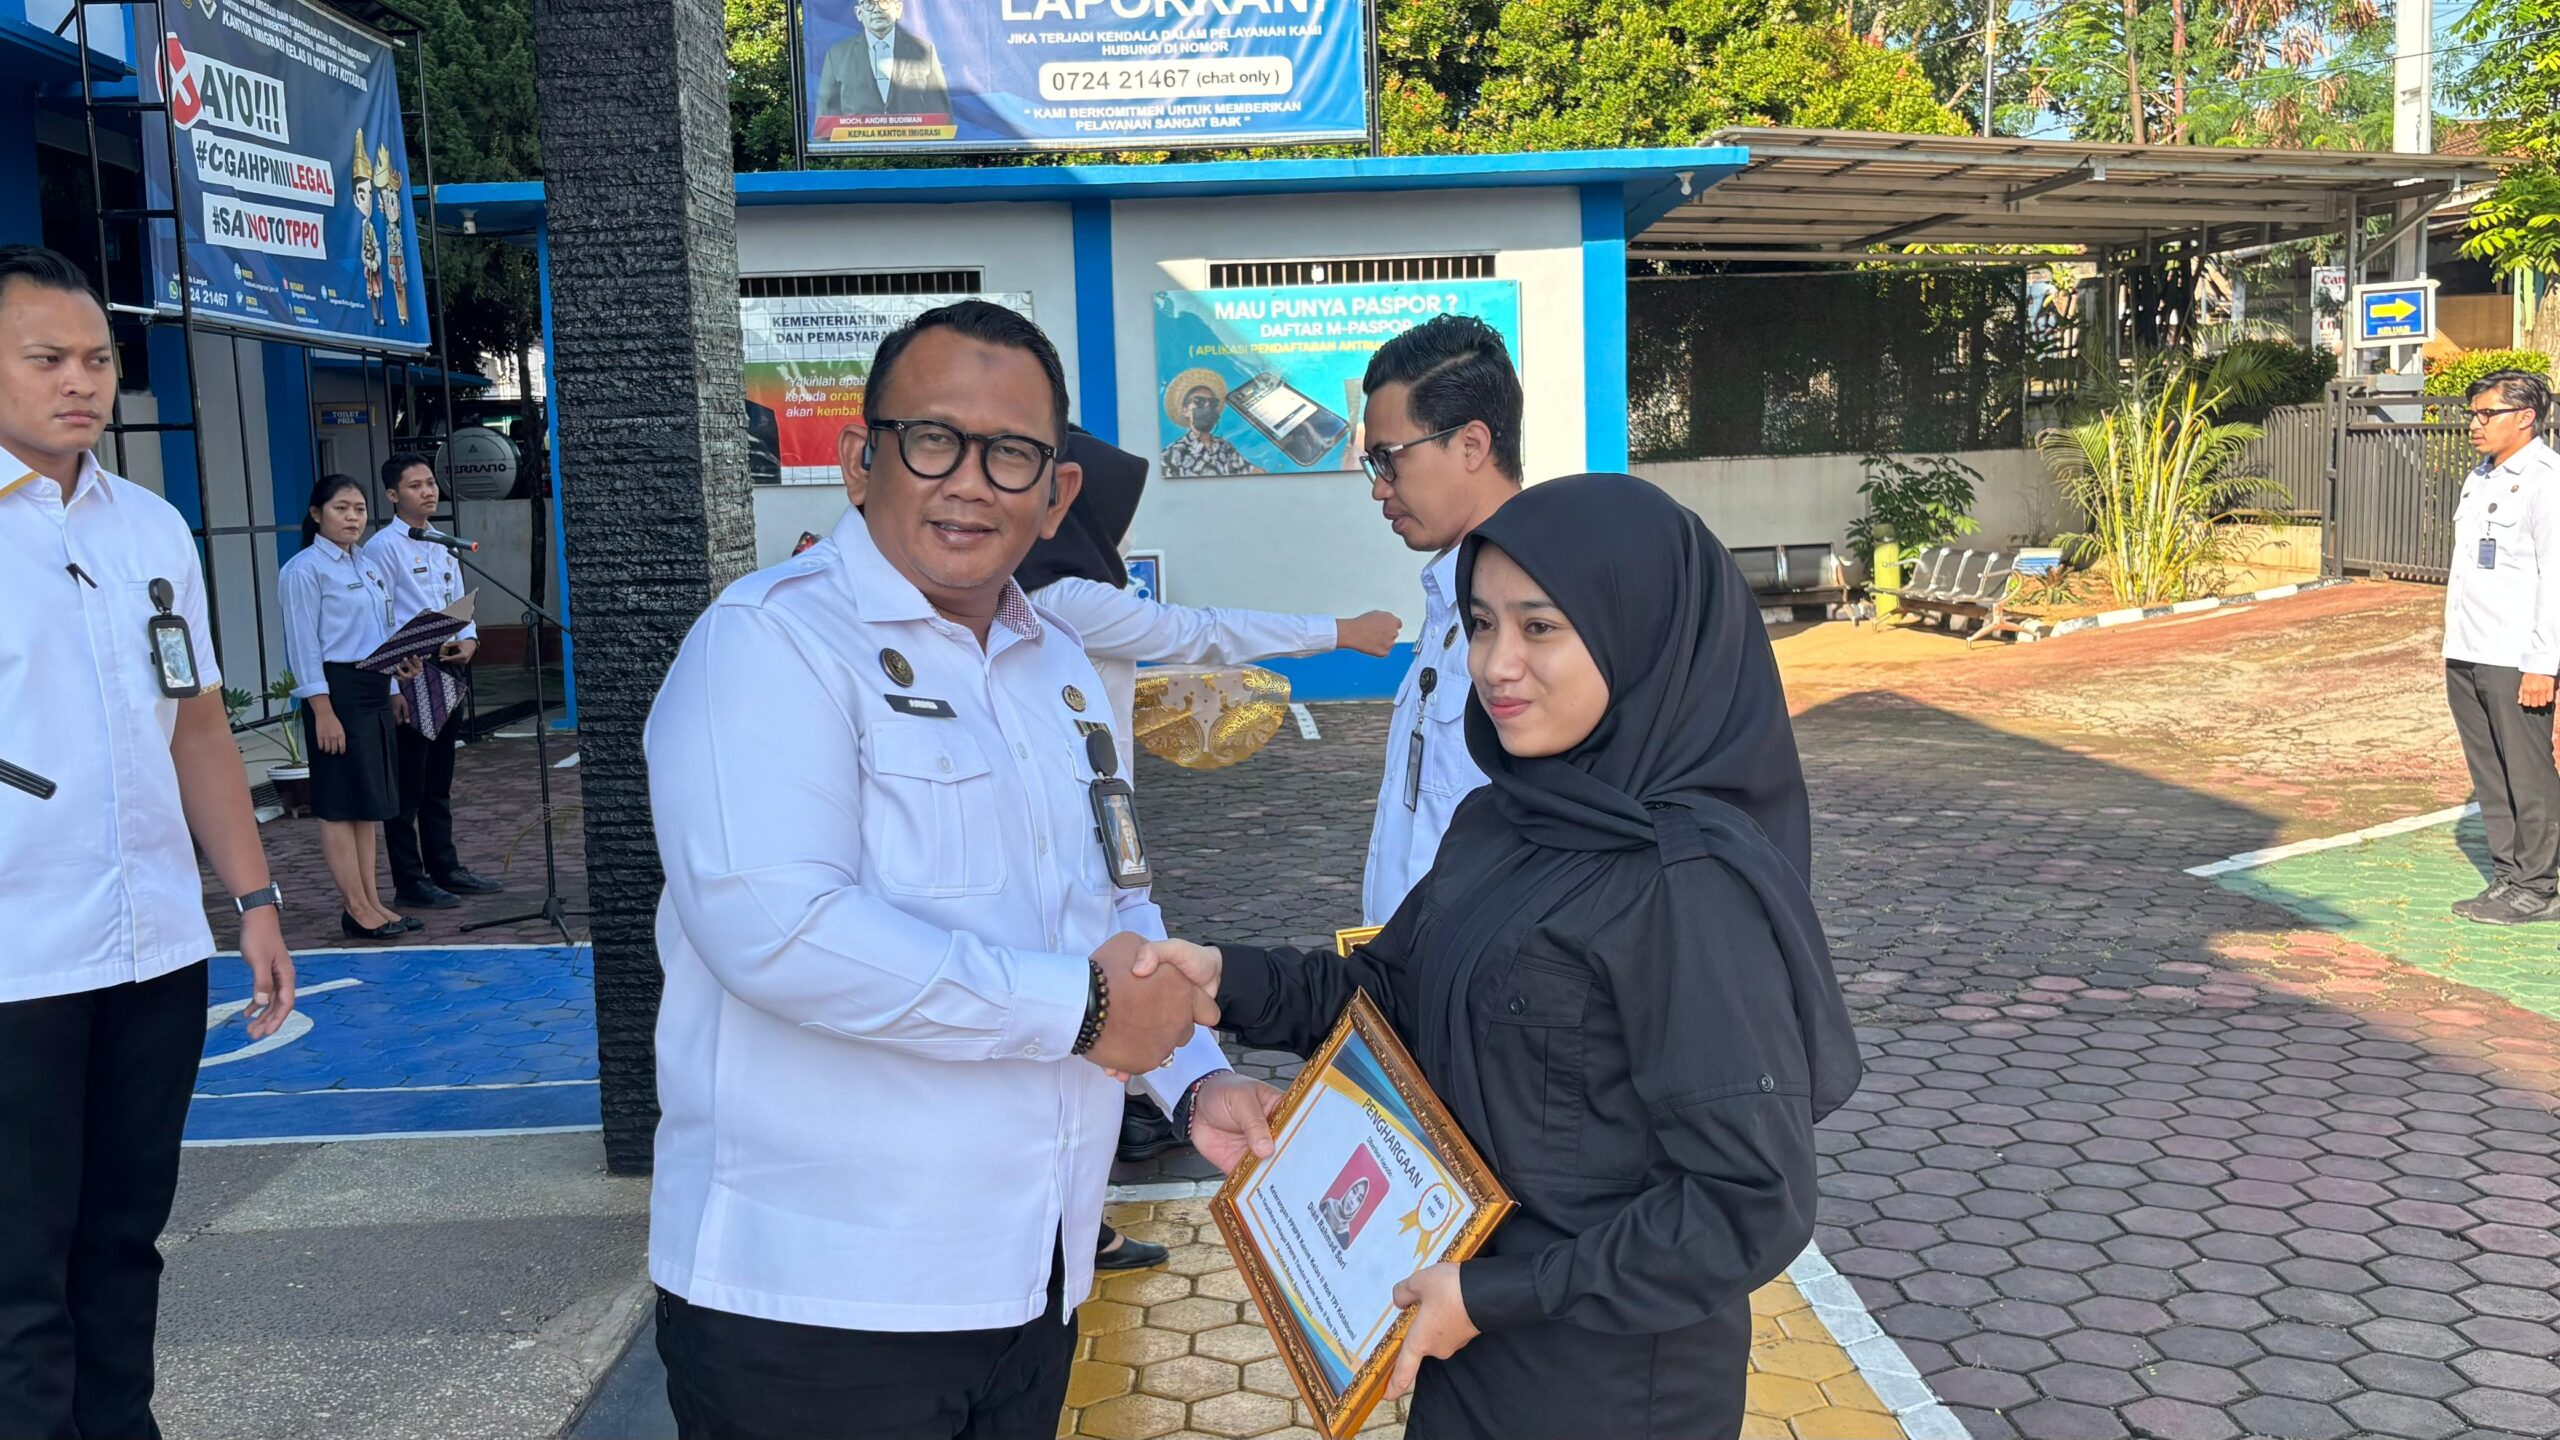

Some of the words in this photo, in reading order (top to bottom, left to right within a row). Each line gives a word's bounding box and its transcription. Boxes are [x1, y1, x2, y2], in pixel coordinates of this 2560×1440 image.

[1007, 32, 1037, 44] JIKA
[1039, 31, 1093, 44] TERJADI
[1097, 30, 1158, 42] KENDALA
[1161, 29, 1207, 41] DALAM
[1210, 26, 1286, 39] PELAYANAN
[1290, 25, 1322, 36] KAMI
[1102, 45, 1161, 56] HUBUNGI
[1164, 44, 1177, 54] DI
[1179, 42, 1229, 53] NOMOR
[1052, 71, 1110, 91] 0724
[1119, 69, 1190, 90] 21467
[1196, 71, 1236, 88] (chat
[1034, 107, 1066, 119] KAMI
[1070, 105, 1165, 119] BERKOMITMEN
[1167, 103, 1212, 116] UNTUK
[1215, 101, 1301, 115] MEMBERIKAN
[889, 116, 922, 124] BUDIMAN
[1076, 119, 1151, 131] PELAYANAN
[1155, 117, 1207, 129] SANGAT
[1211, 116, 1242, 128] BAIK
[848, 130, 876, 138] KEPALA
[877, 129, 907, 137] KANTOR
[908, 128, 941, 137] IMIGRASI
[203, 289, 229, 308] 21467
[1214, 300, 1265, 320] MAU
[1271, 298, 1347, 319] PUNYA
[1352, 294, 1441, 315] PASPOR
[772, 314, 866, 327] KEMENTERIAN
[777, 332, 803, 343] DAN
[808, 330, 889, 343] PEMASYARA
[1261, 322, 1323, 338] DAFTAR
[1196, 345, 1249, 356] APLIKASI
[1251, 340, 1336, 354] PENDAFTARAN
[839, 376, 867, 389] apab
[785, 391, 826, 404] kepada
[786, 406, 813, 418] akan
[1361, 1096, 1423, 1190] PENGHARGAAN
[1306, 1200, 1320, 1222] Dian
[1316, 1218, 1337, 1253] Rahmad
[1334, 1248, 1347, 1270] Sari
[1309, 1256, 1321, 1277] Kelas
[1322, 1280, 1332, 1297] Non
[1330, 1294, 1339, 1309] TPI
[1336, 1305, 1356, 1341] Kotabumi
